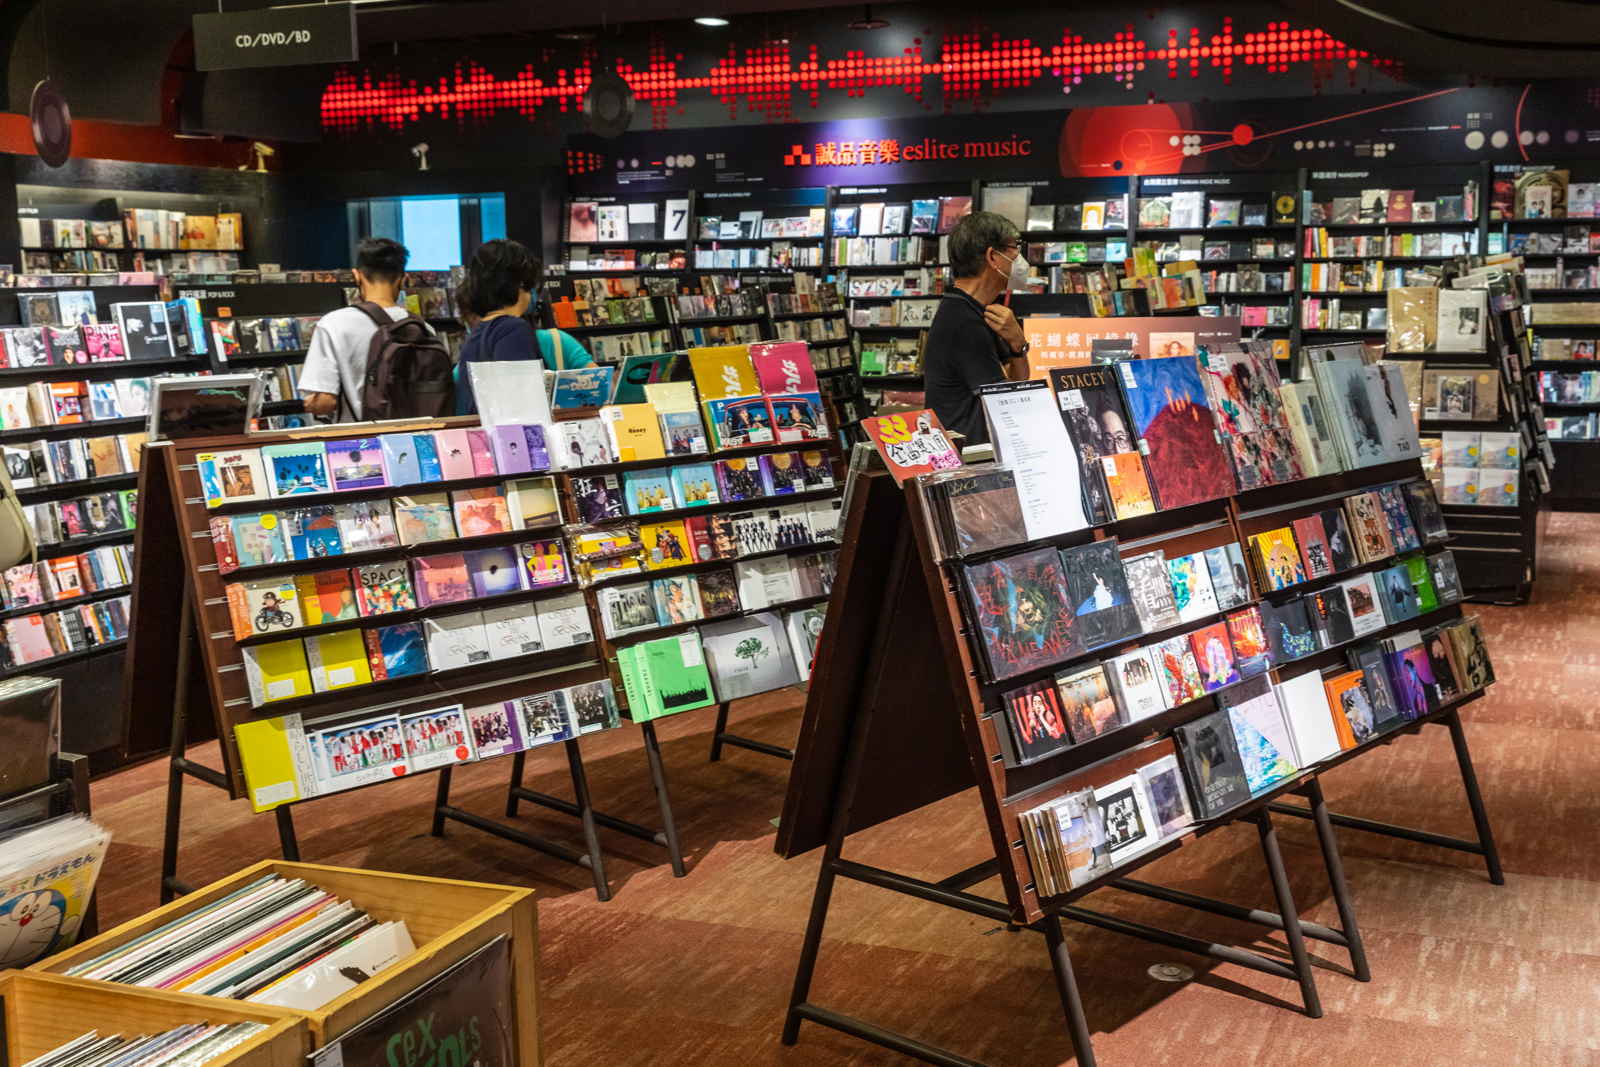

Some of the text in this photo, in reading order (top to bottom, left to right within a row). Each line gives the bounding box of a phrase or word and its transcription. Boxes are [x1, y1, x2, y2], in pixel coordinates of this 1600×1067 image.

[235, 30, 311, 49] CD/DVD/BD
[815, 140, 900, 165] 誠品音樂
[903, 134, 1032, 161] eslite music
[672, 210, 687, 232] 7
[1060, 371, 1105, 389] STACEY
[361, 567, 407, 586] SPACY
